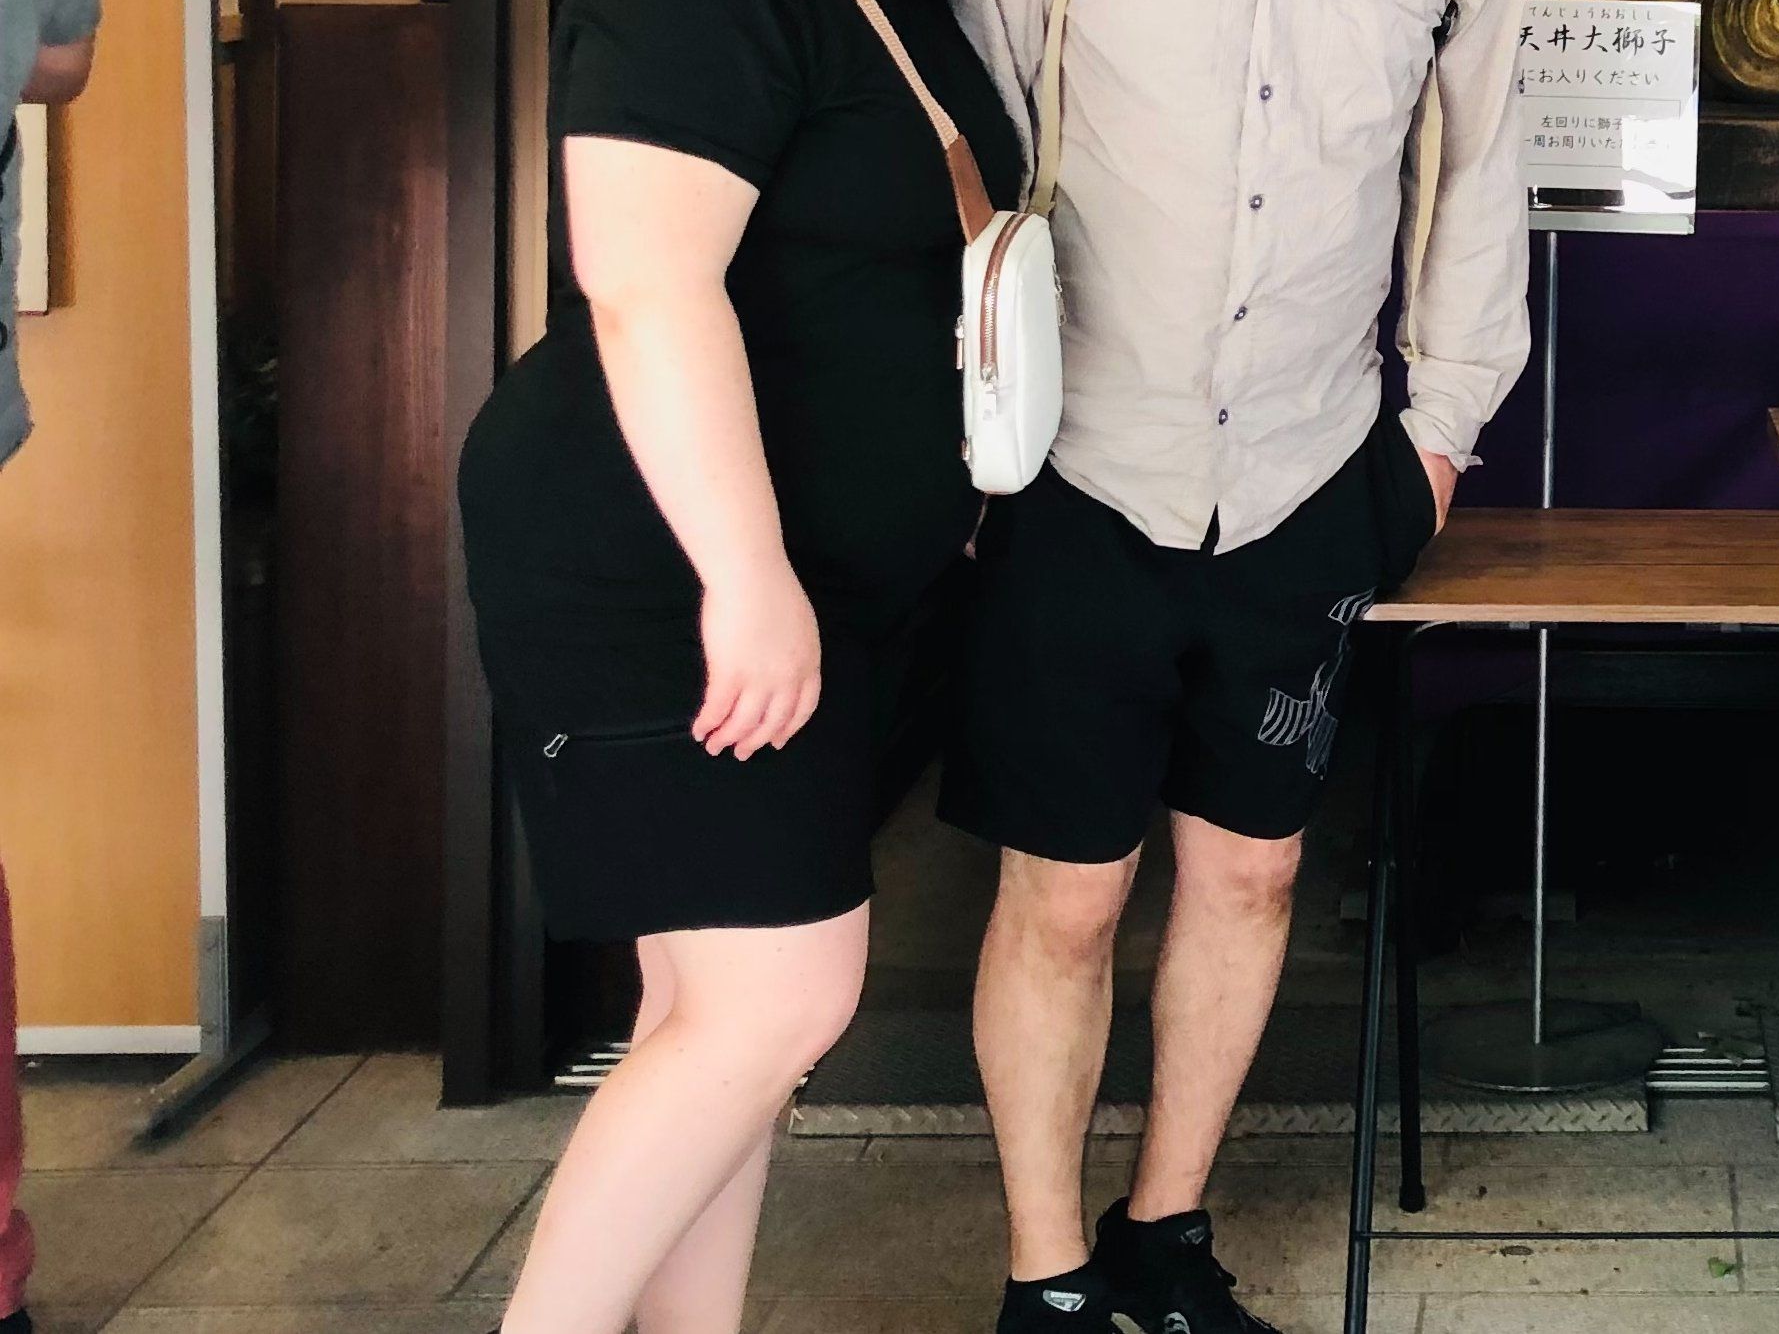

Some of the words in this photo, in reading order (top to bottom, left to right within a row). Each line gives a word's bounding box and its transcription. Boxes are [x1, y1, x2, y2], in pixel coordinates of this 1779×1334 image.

[1519, 23, 1677, 56] 天井大獅子
[1520, 67, 1660, 87] にお入りください
[1523, 134, 1623, 149] 一周お周りいた
